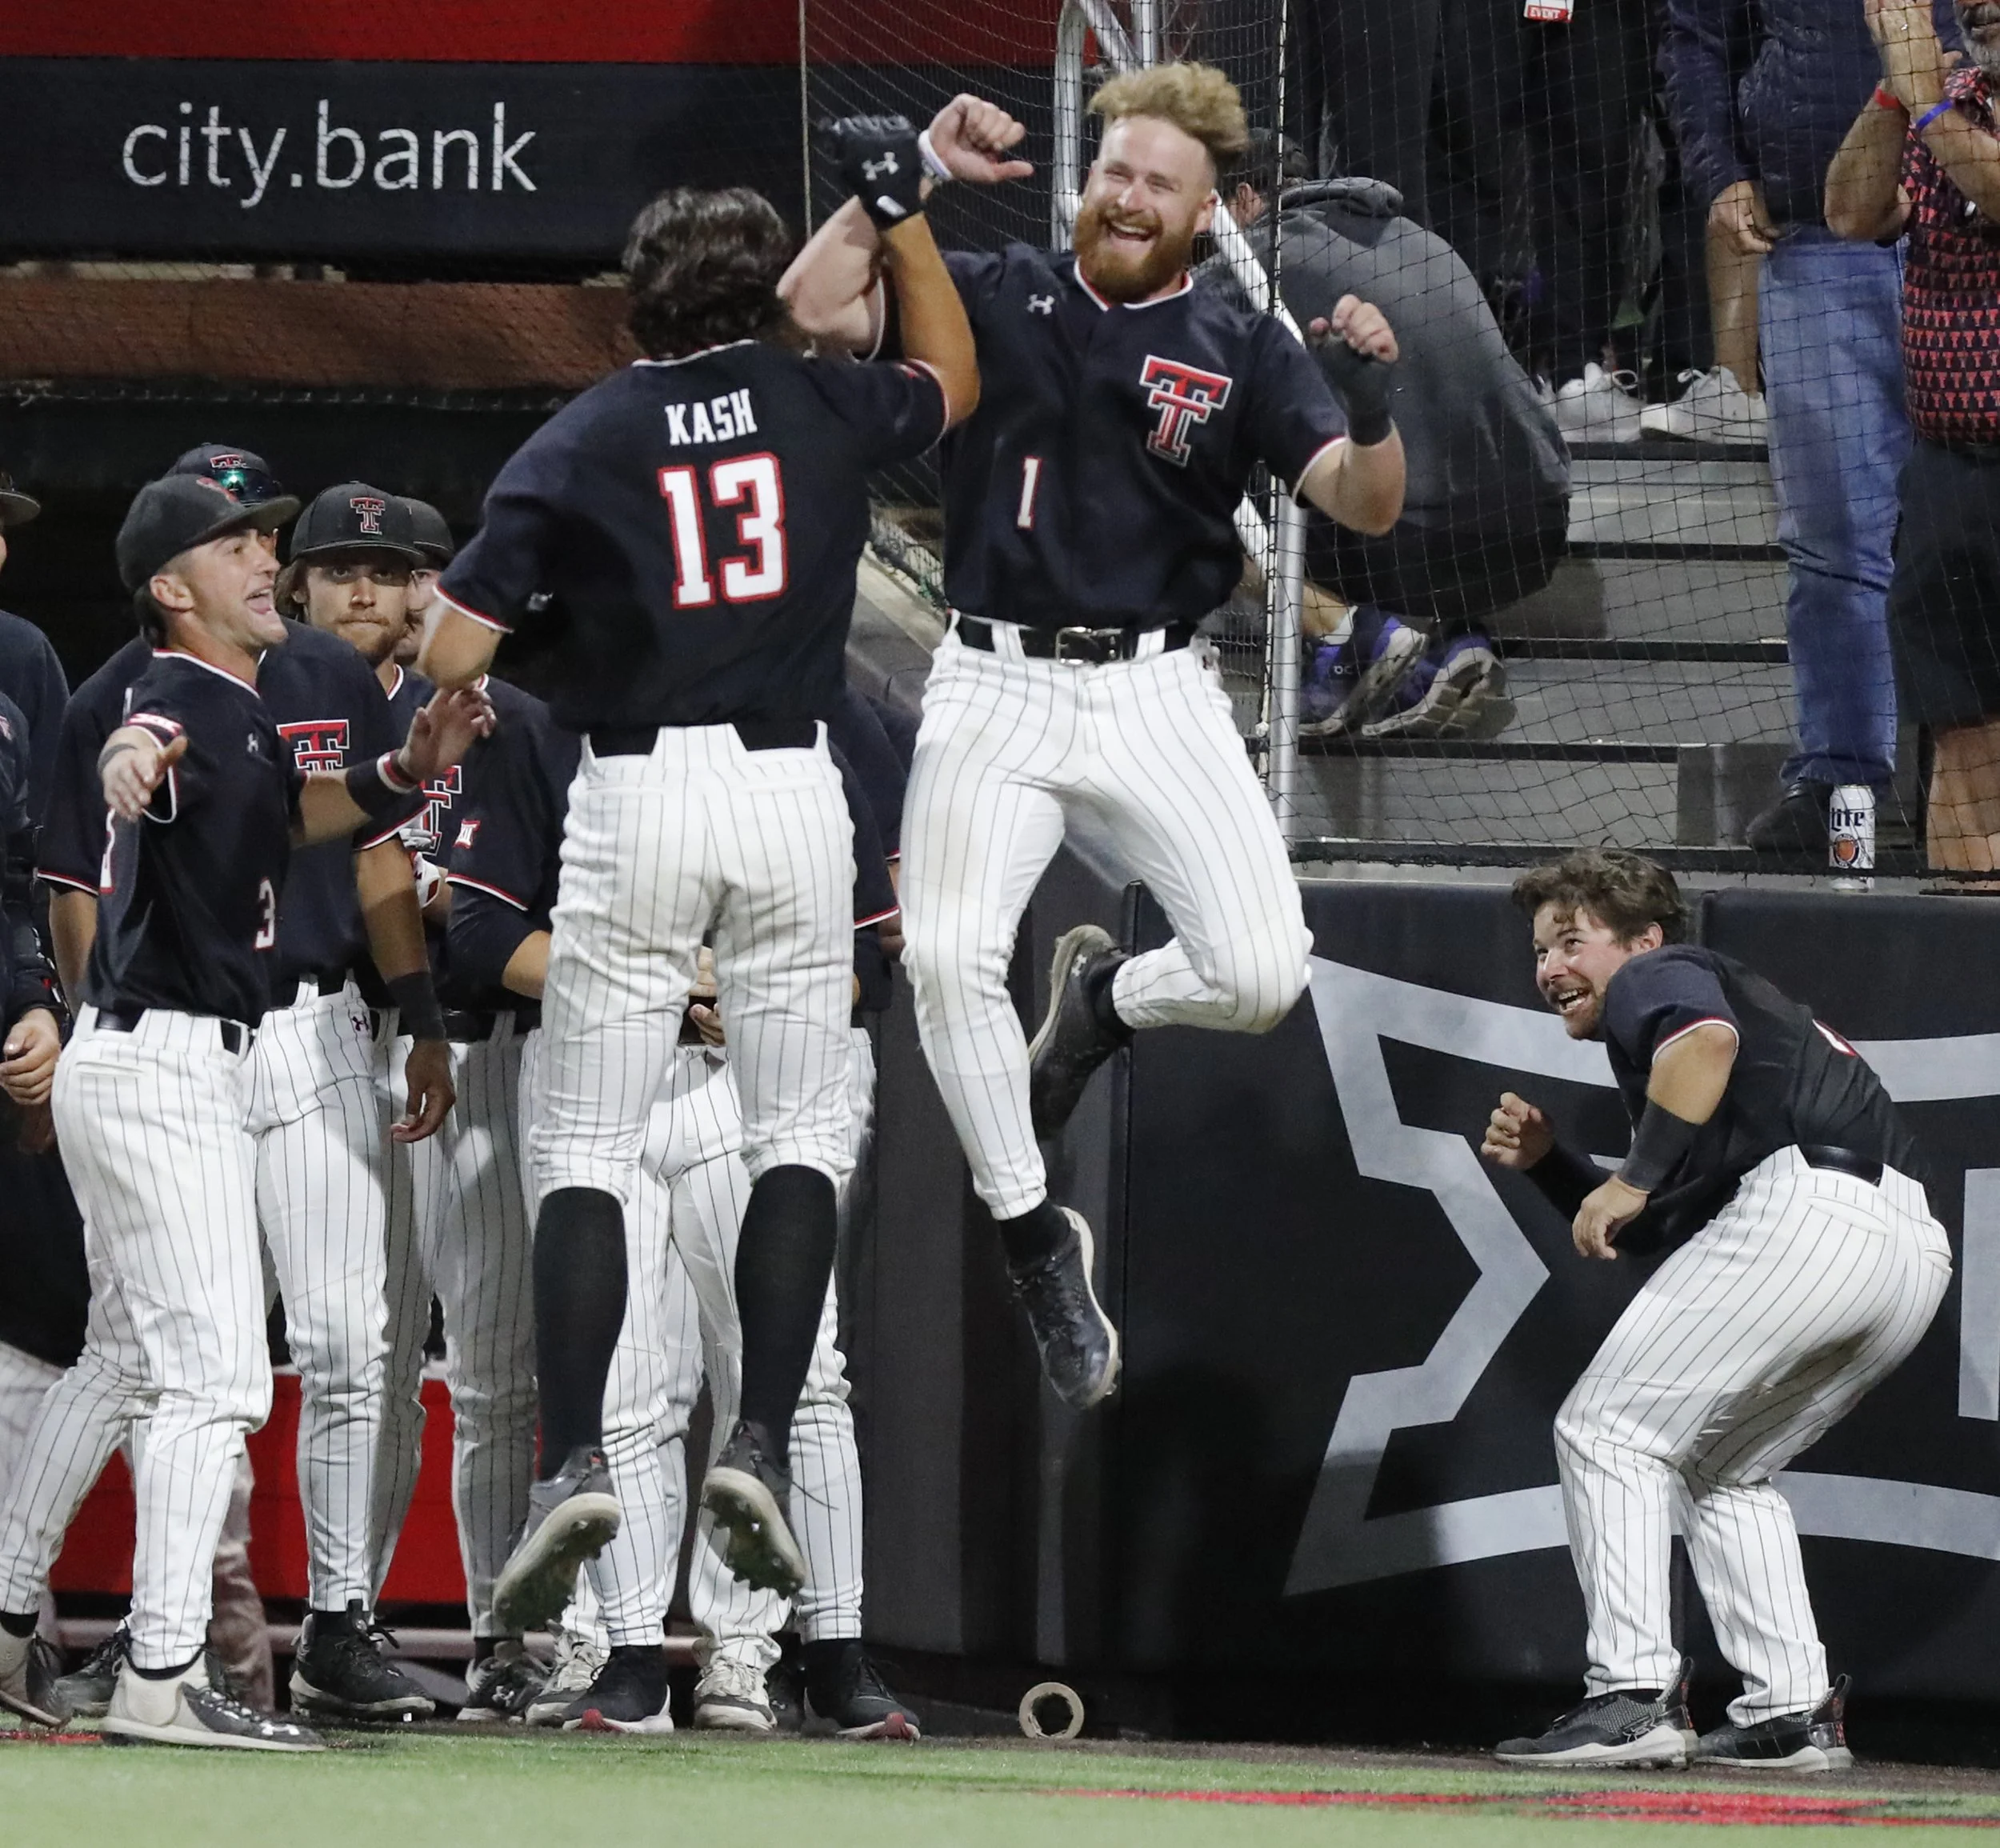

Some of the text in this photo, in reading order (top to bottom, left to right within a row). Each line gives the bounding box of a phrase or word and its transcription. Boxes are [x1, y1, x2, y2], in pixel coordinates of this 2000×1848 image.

[122, 98, 538, 209] city.bank
[665, 387, 758, 446] KASH
[1017, 455, 1042, 530] 1
[657, 450, 788, 610] 13
[1830, 807, 1865, 832] Lite
[254, 877, 276, 950] 3
